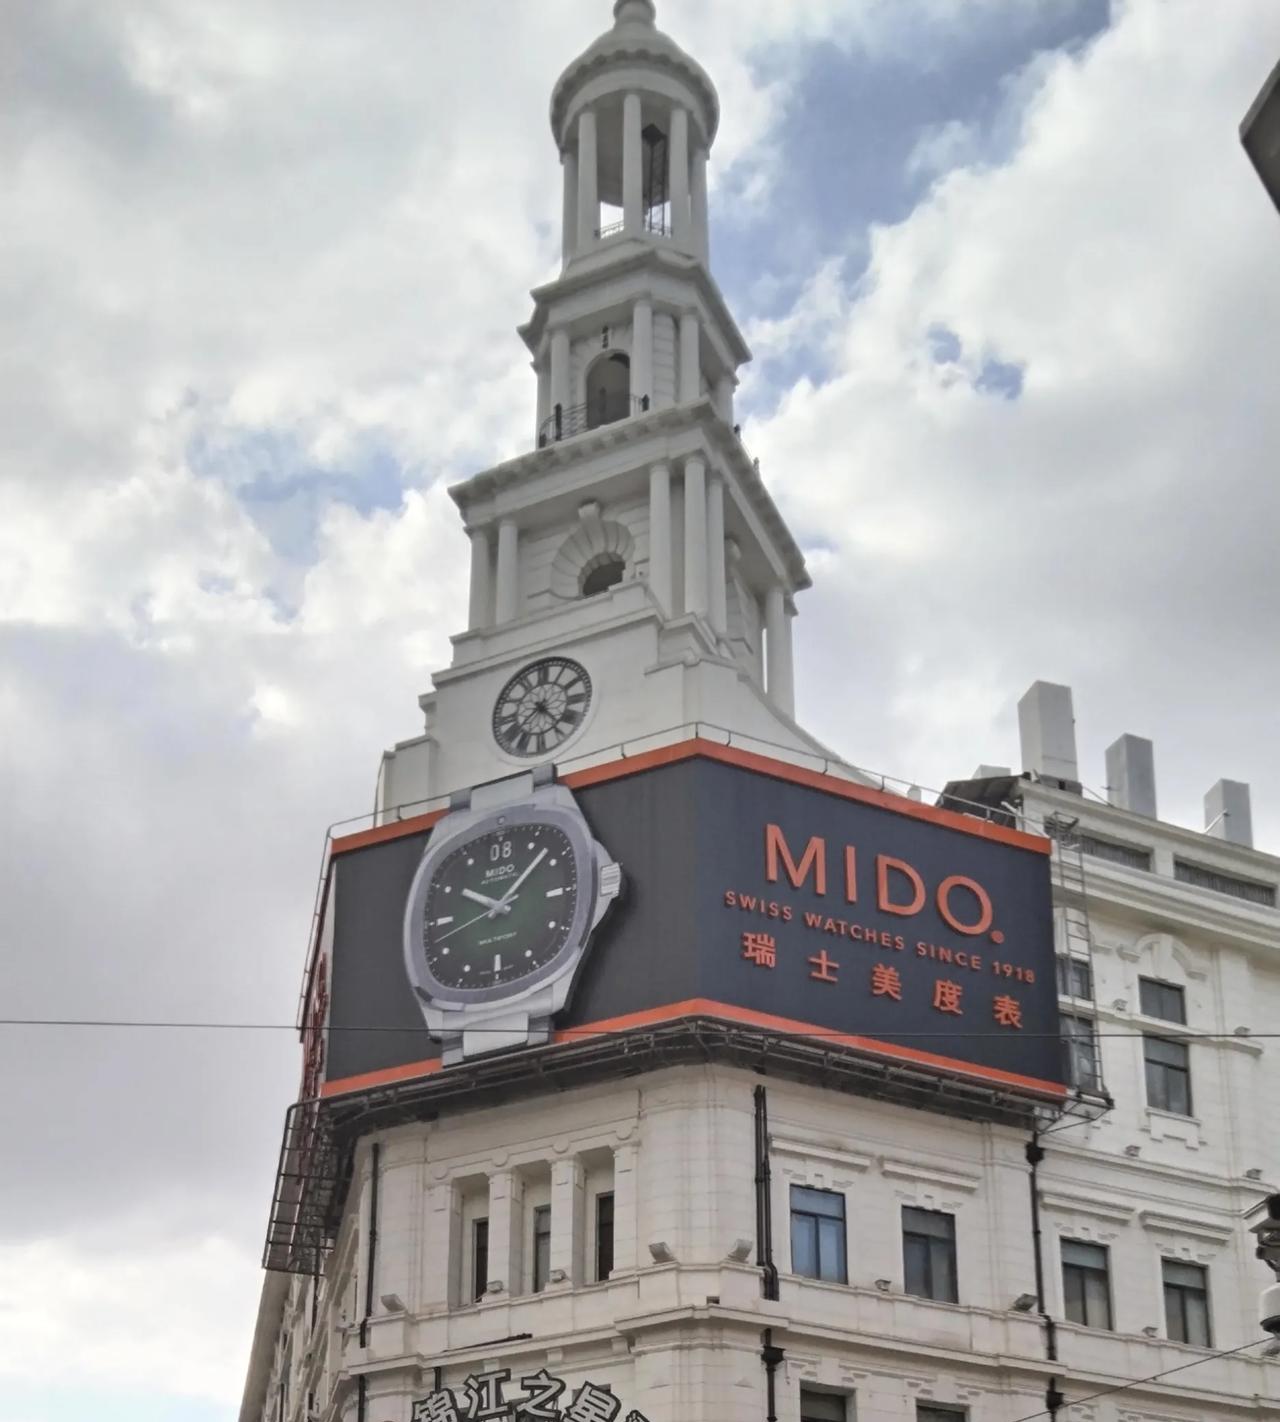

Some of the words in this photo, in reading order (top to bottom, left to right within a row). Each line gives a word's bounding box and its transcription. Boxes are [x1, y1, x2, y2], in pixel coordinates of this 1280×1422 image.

[485, 864, 515, 878] MIDO
[490, 841, 512, 861] 08
[766, 823, 993, 936] MIDO
[725, 890, 793, 921] SWISS
[805, 911, 905, 950] WATCHES
[917, 942, 982, 970] SINCE
[993, 961, 1036, 984] 1918
[743, 931, 1023, 1029] 瑞士美度表
